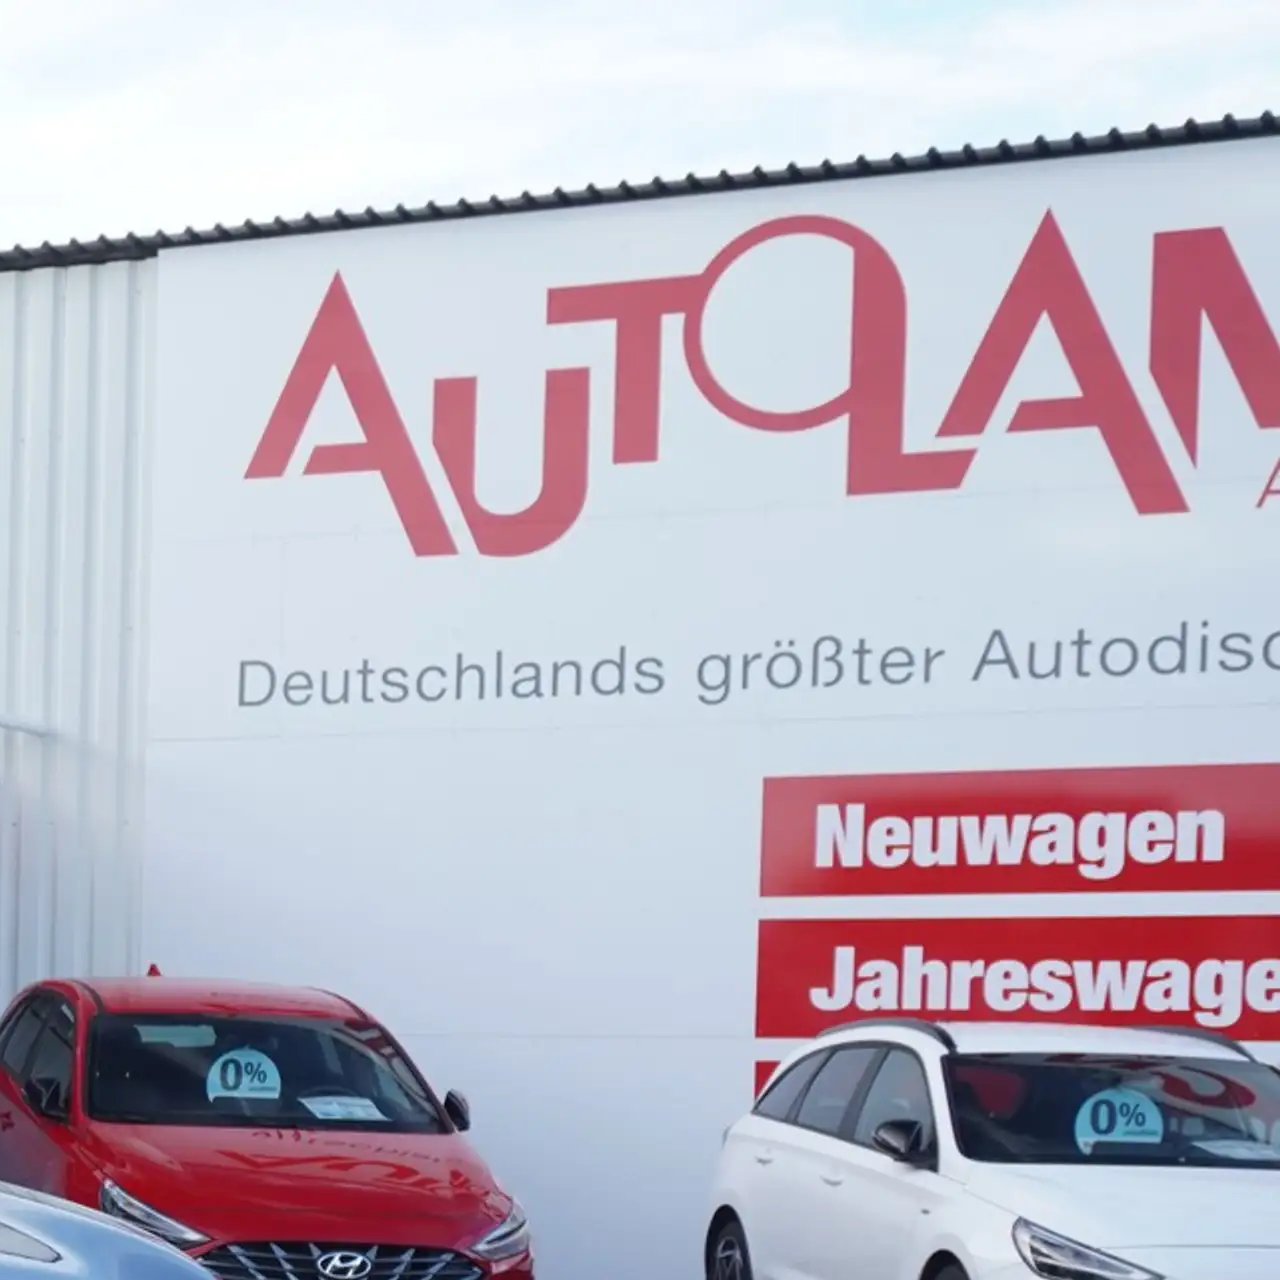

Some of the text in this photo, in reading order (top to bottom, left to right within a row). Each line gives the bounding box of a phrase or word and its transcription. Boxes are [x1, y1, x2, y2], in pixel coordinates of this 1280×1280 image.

[237, 646, 665, 708] Deutschlands
[696, 635, 946, 705] größter
[814, 803, 1225, 880] Neuwagen
[809, 945, 1280, 1028] Jahreswage
[220, 1058, 268, 1092] 0%
[1089, 1098, 1147, 1137] 0%
